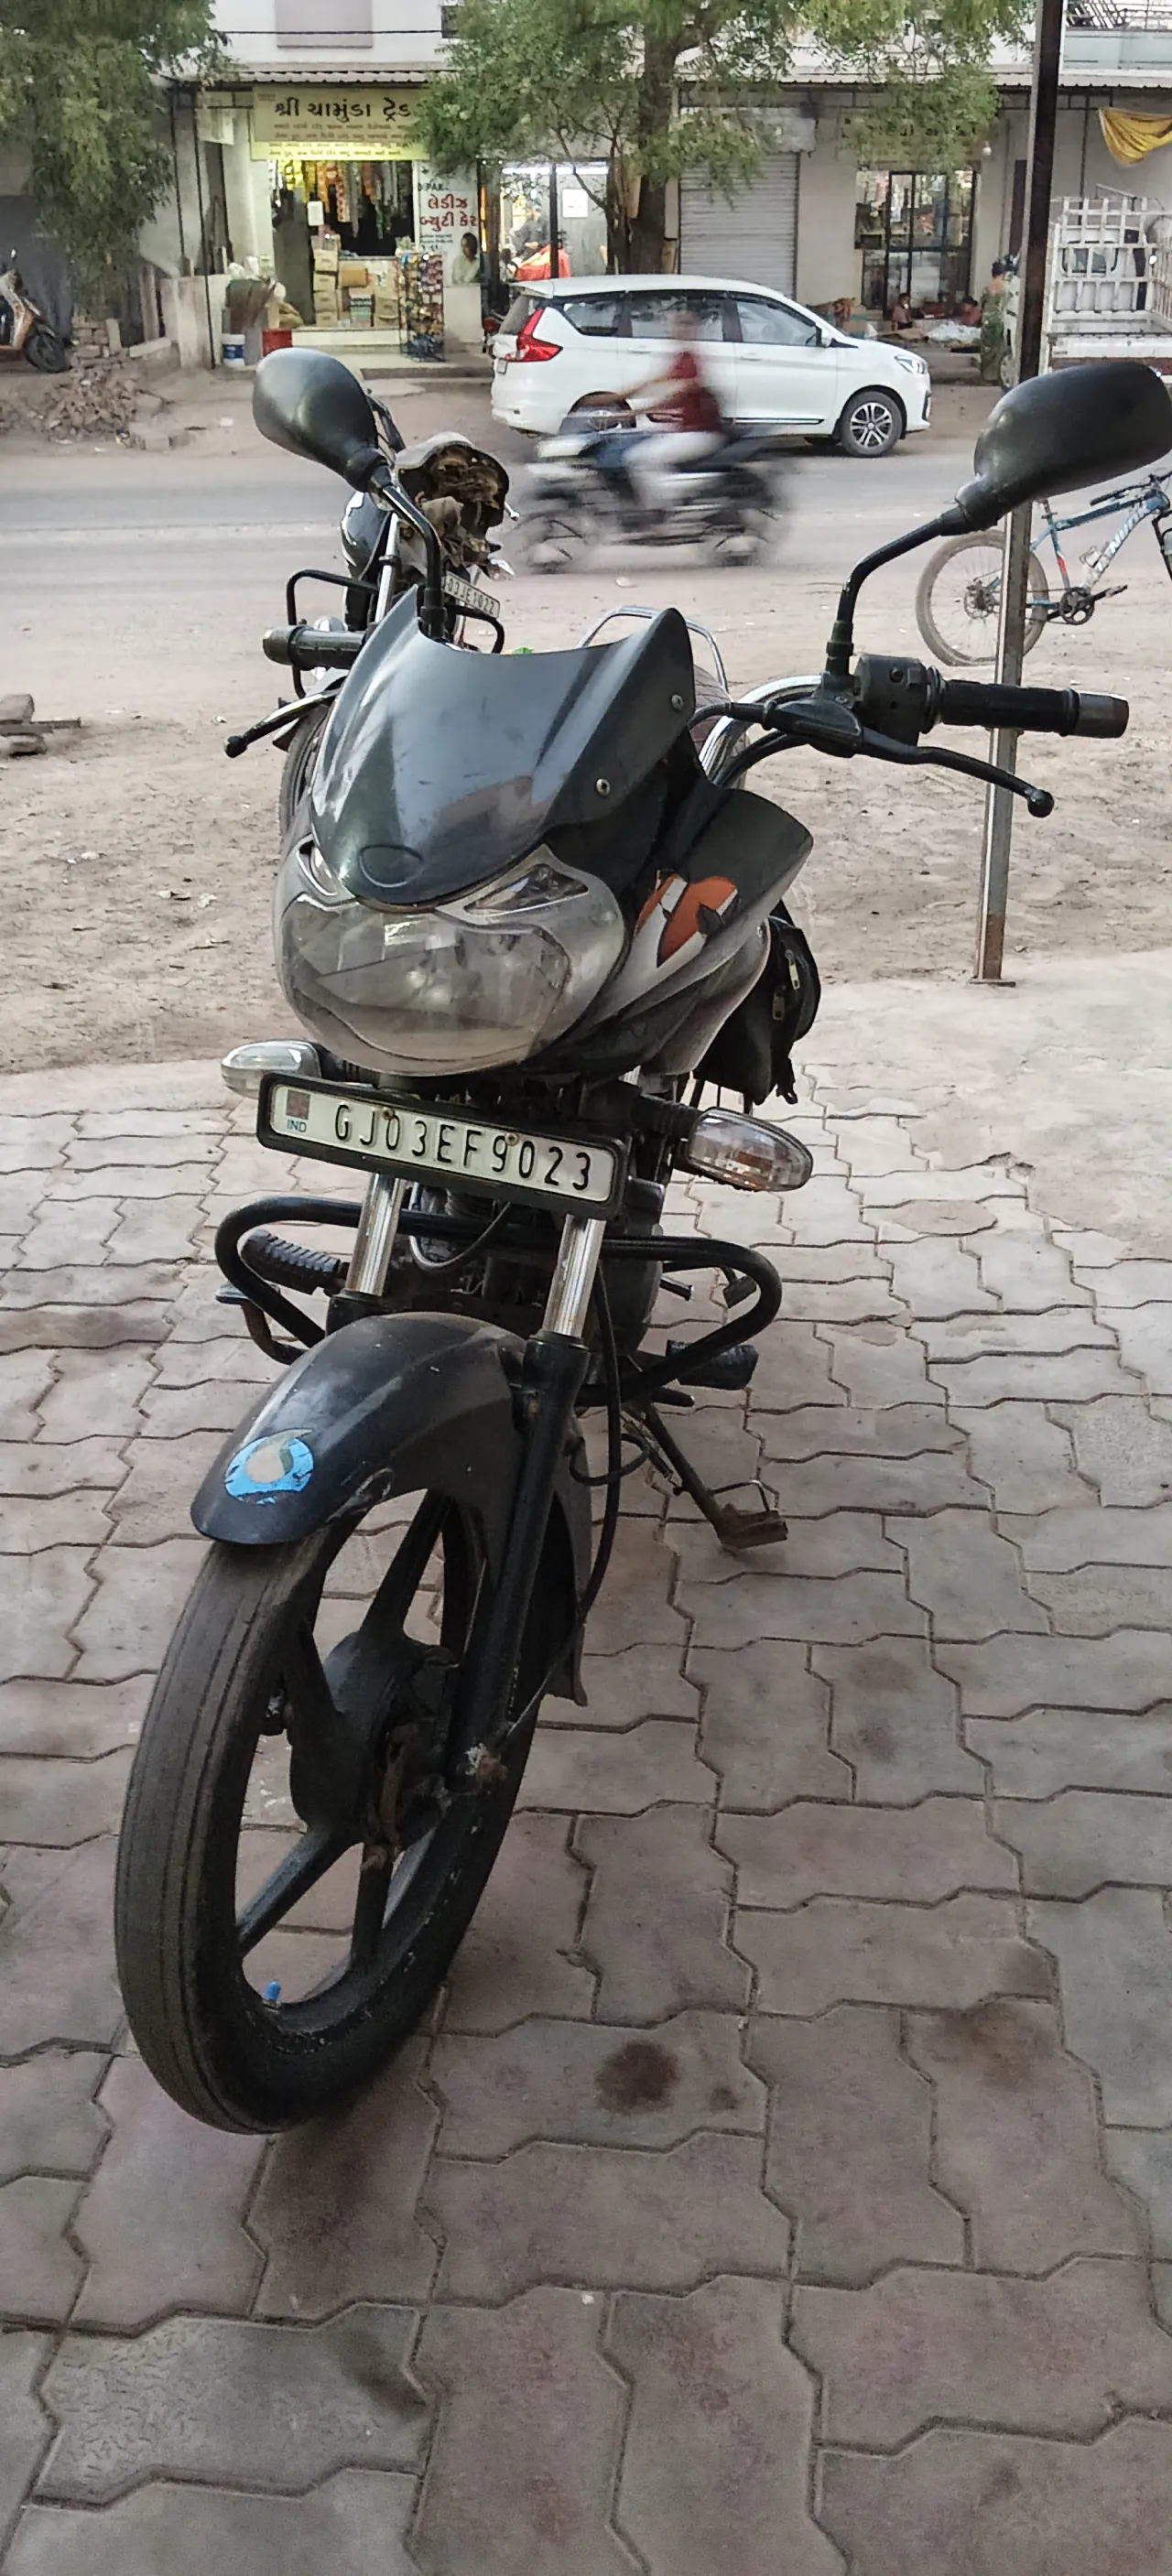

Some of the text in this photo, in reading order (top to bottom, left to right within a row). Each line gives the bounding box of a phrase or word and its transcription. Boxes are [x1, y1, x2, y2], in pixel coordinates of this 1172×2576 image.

[275, 96, 411, 124] શ્રી ચામુંડા ટ્રેડ
[428, 193, 468, 209] લેડીઝ
[419, 211, 454, 232] બ્યુટી
[287, 1119, 307, 1133] IND
[334, 1103, 591, 1191] GJ03EF9023
